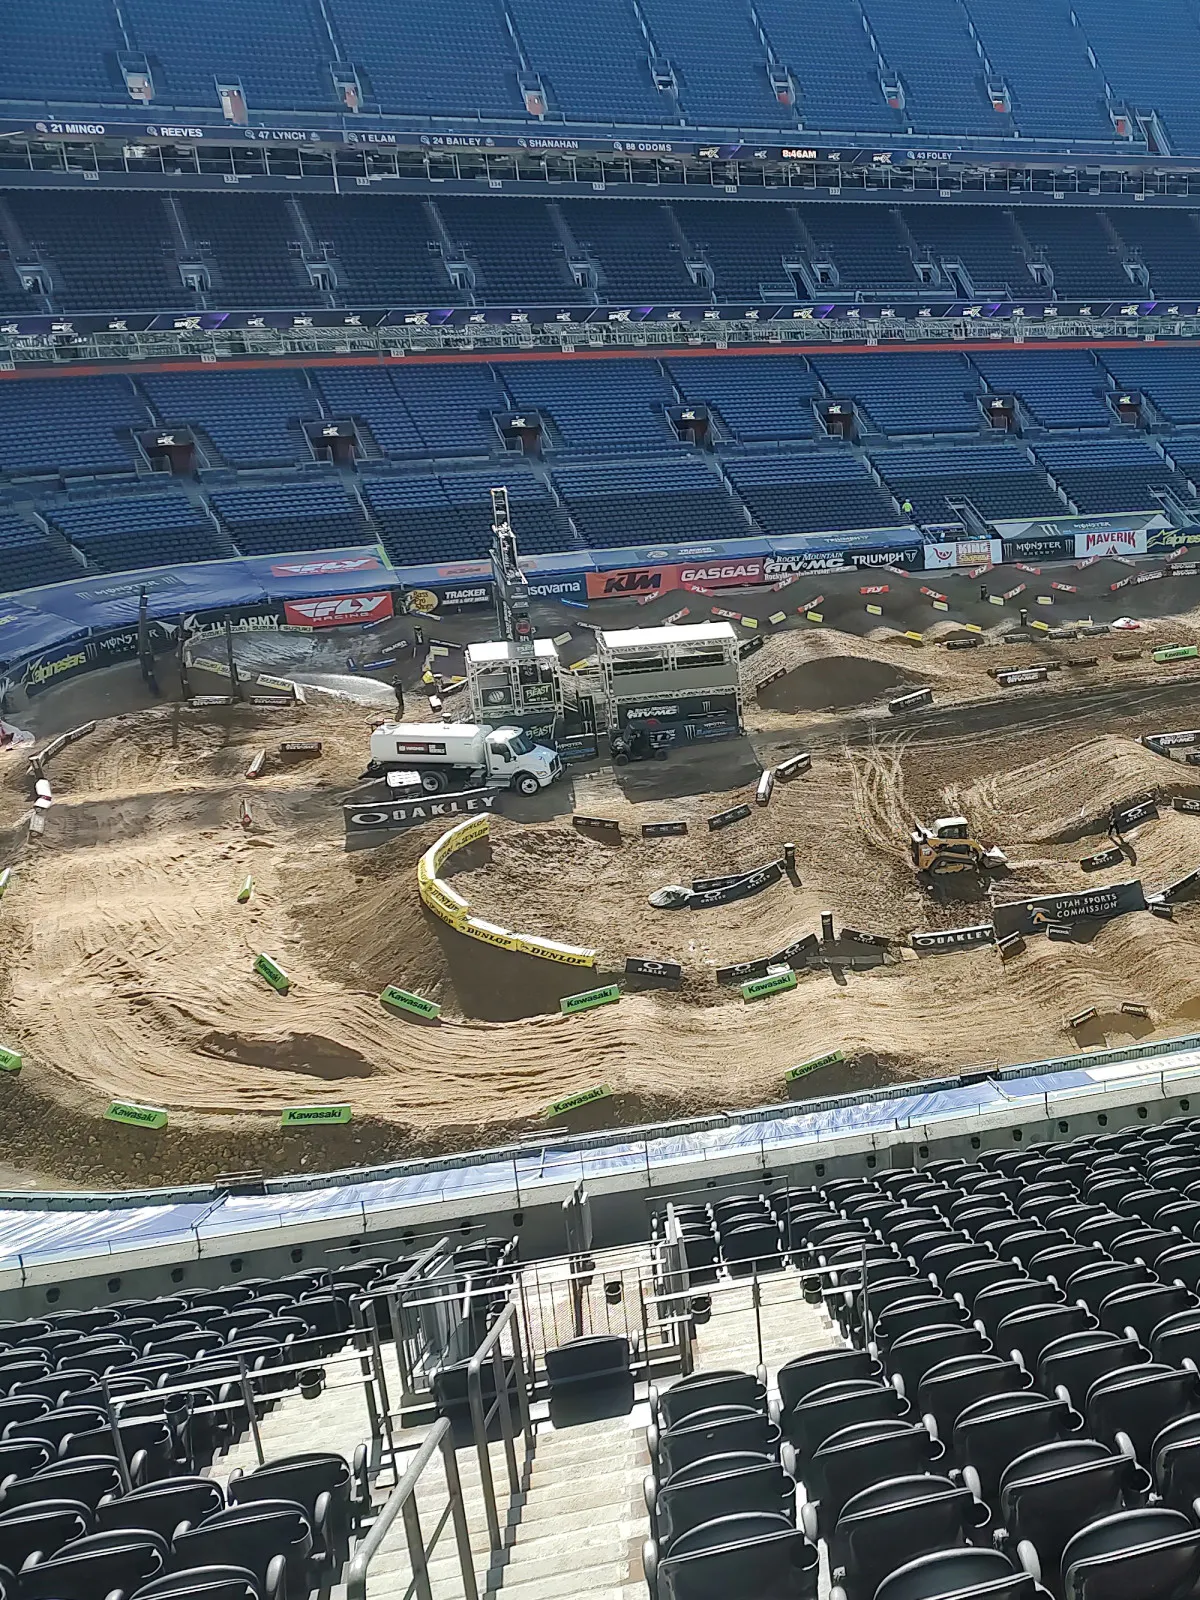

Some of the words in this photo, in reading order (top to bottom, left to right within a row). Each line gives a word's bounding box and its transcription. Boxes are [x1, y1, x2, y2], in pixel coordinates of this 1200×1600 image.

[51, 124, 64, 133] 21
[65, 124, 105, 135] MINGO
[160, 127, 203, 138] REEVES
[258, 130, 270, 140] 47
[271, 131, 306, 141] LYNCH
[369, 134, 396, 143] ELAM
[432, 136, 444, 145] 24
[446, 136, 481, 147] BAILEY
[529, 138, 579, 149] SHANAHAN
[626, 142, 637, 151] 88
[638, 142, 672, 152] ODOMS
[782, 149, 817, 159] 8:46AM
[926, 152, 952, 160] FOLEY
[1016, 541, 1062, 552] MONSTER
[1086, 531, 1136, 551] MAVERIK
[776, 555, 801, 563] ROCKY
[802, 551, 844, 561] MOUNTAIN
[852, 550, 904, 567] TRIUMPH
[681, 563, 760, 583] GASGAS
[974, 565, 988, 576] FLY
[1022, 565, 1036, 573] FLY
[527, 580, 581, 597] sqvarna
[604, 572, 662, 594] KTM
[779, 577, 792, 588] FLY
[1057, 583, 1073, 591] FLY
[445, 588, 486, 600] TRACKER
[644, 591, 660, 602] FLY
[866, 586, 883, 594] FLY
[926, 589, 942, 598] FLY
[1012, 586, 1023, 597] FLY
[289, 595, 387, 619] FLY
[803, 598, 819, 611] FLY
[313, 612, 370, 622] RACING
[668, 610, 682, 623] FLY
[718, 608, 734, 618] FLY
[239, 614, 280, 627] ARMY
[100, 628, 158, 651] MONSTR
[35, 650, 86, 685] alpinestars
[392, 796, 497, 821] OAKLEY
[1056, 898, 1080, 910] UTAH
[1083, 892, 1117, 906] SPORTS
[1056, 901, 1118, 919] COMMISSION
[466, 926, 512, 946] DUNLOP
[936, 929, 992, 945] OAKLEY
[531, 946, 587, 965] DUNLOP
[256, 958, 282, 983] Kawasaki
[637, 967, 668, 976] OAKLEY
[748, 974, 791, 994] Kawasaki
[388, 989, 433, 1014] Kawasaki
[566, 988, 613, 1008] Kawasaki
[790, 1052, 838, 1079] Kawasaki
[553, 1086, 605, 1114] Kawasaki
[111, 1105, 156, 1123] Kawasaki
[288, 1108, 342, 1121] Kawasaki
